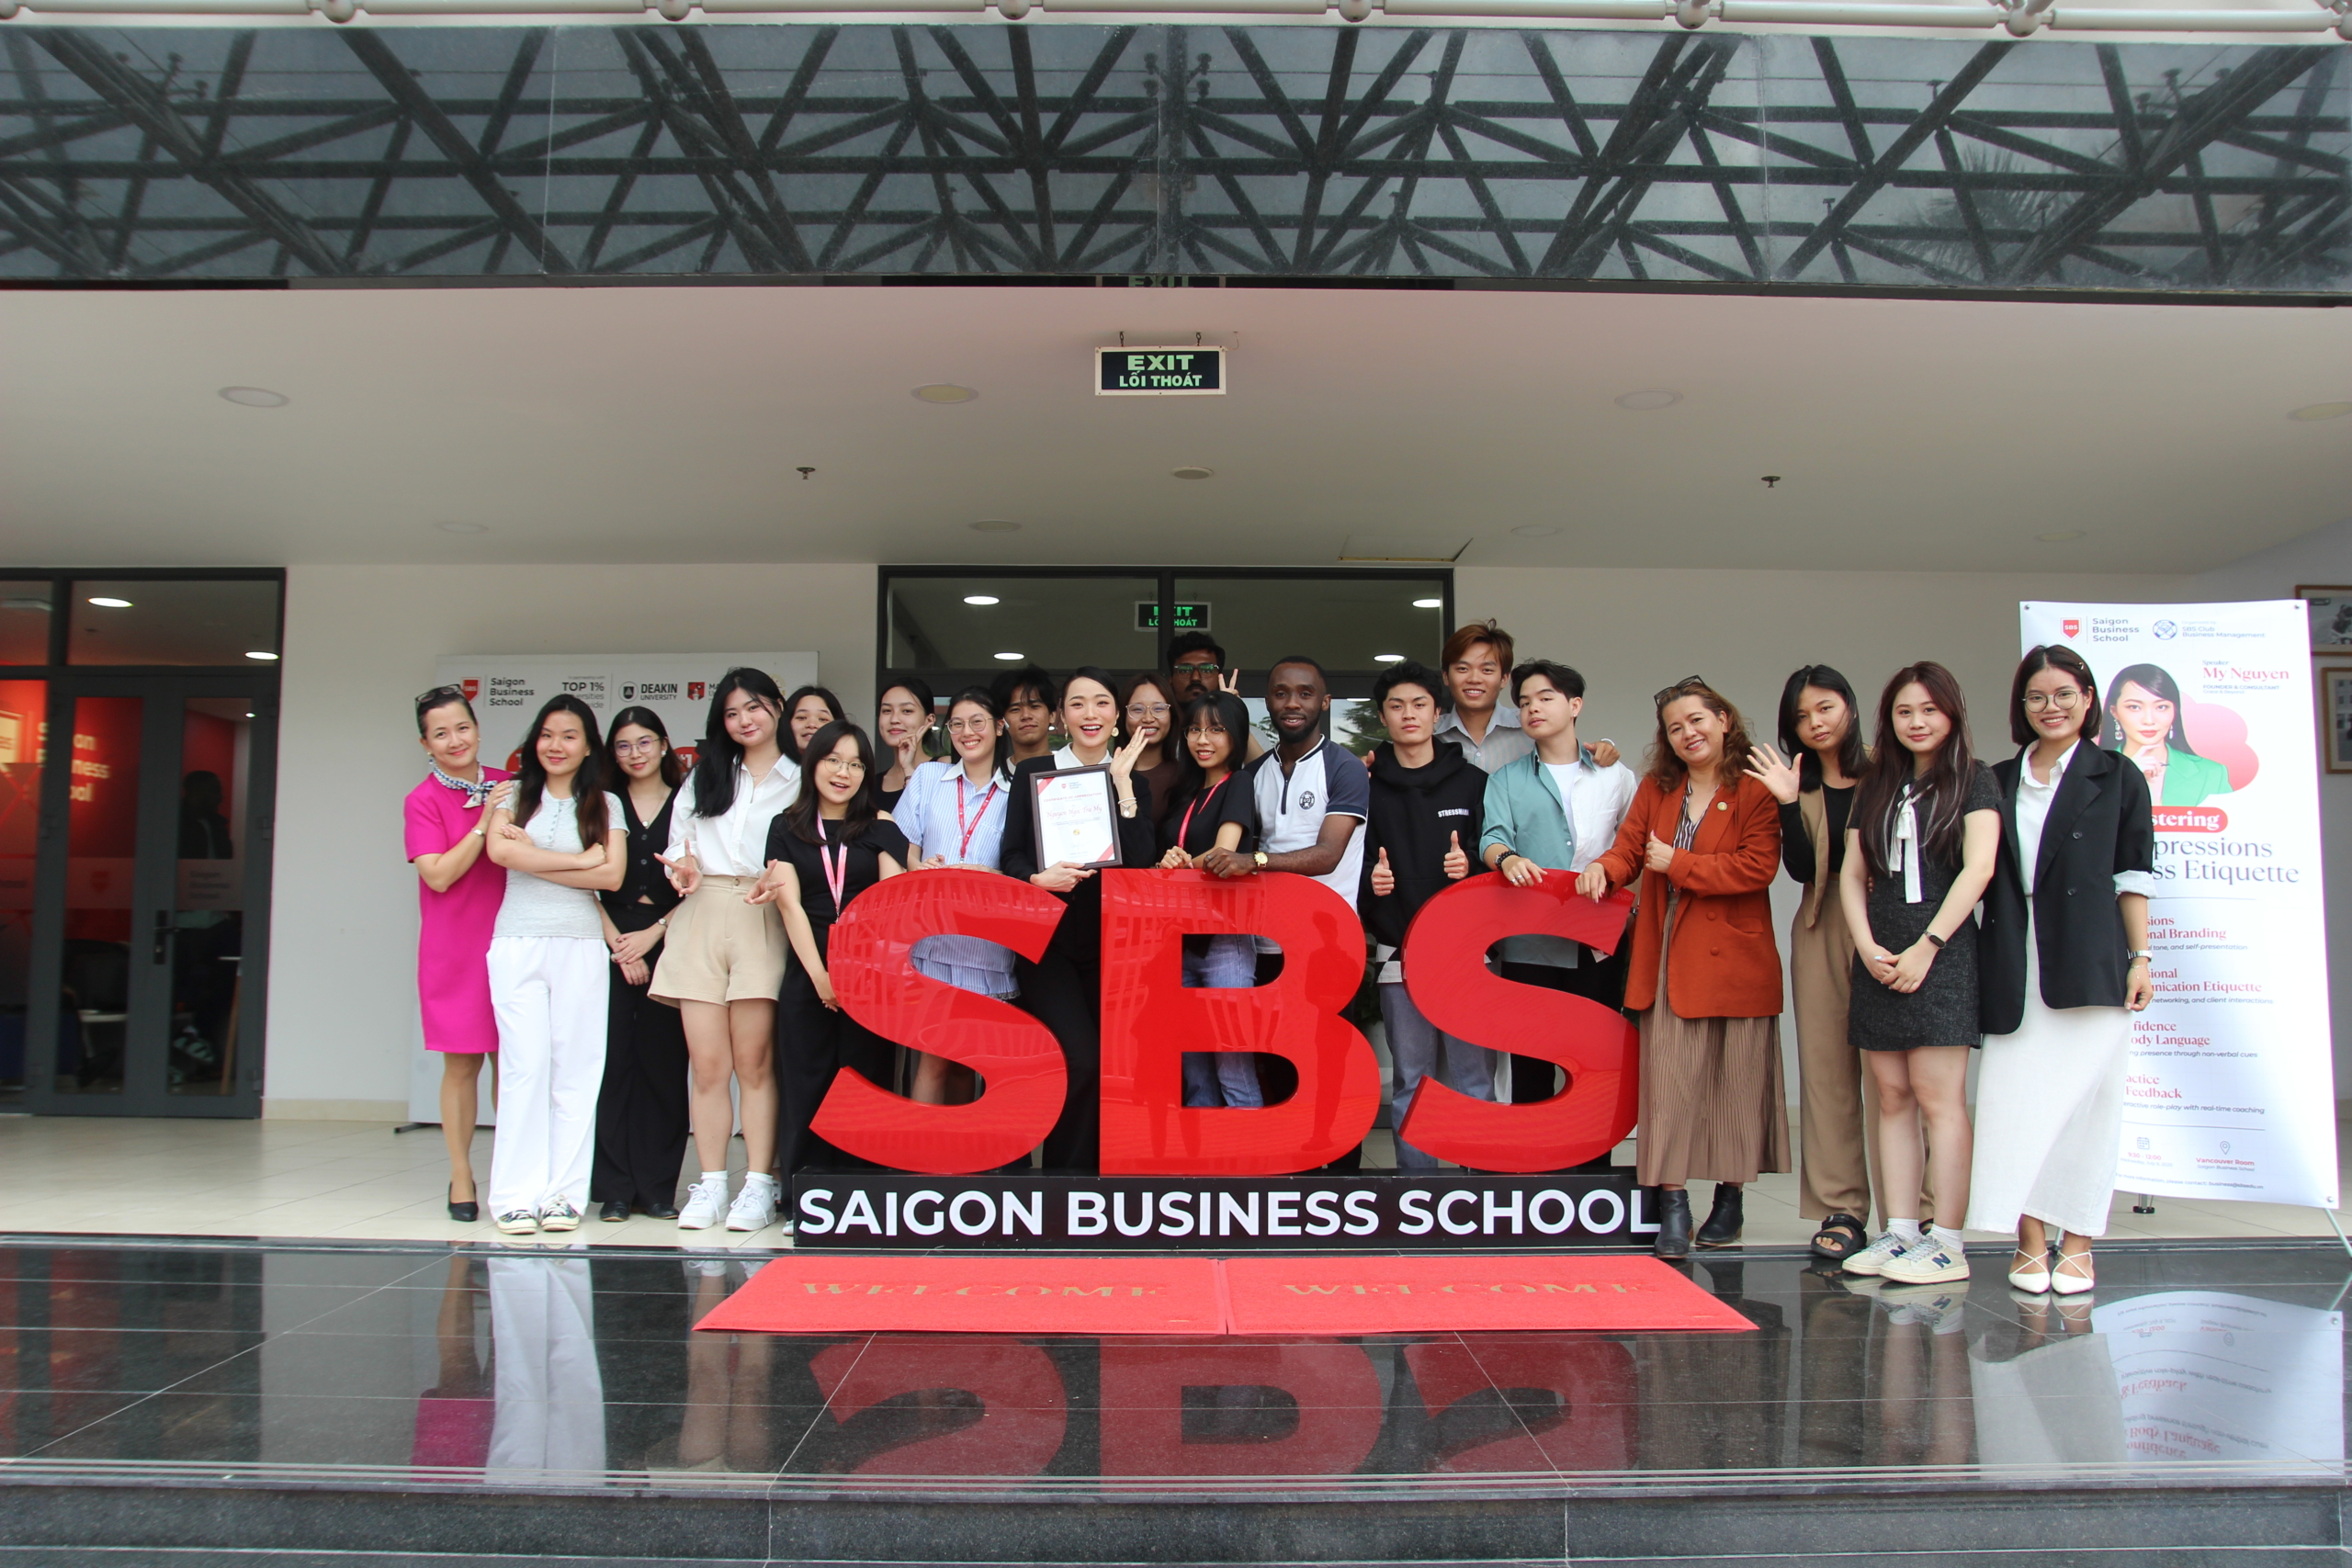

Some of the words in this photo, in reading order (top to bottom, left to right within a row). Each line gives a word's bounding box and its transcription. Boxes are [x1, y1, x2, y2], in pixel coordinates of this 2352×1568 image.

[1127, 355, 1194, 370] EXIT
[1119, 370, 1146, 387] LỐI
[1150, 372, 1203, 387] THOÁT
[2093, 617, 2129, 626] Saigon
[2203, 667, 2227, 681] My
[2231, 667, 2290, 682] Nguyen
[491, 677, 525, 687] Saigon
[562, 682, 586, 692] TOP
[590, 682, 605, 692] 1%
[640, 683, 678, 694] DEAKIN
[490, 698, 523, 706] School
[2152, 810, 2220, 831] stering
[2154, 837, 2273, 860] pressions
[2185, 860, 2300, 886] Etiquette
[2169, 928, 2226, 941] Branding
[2204, 981, 2262, 994] Etiquette
[808, 867, 1642, 1176] SBS
[2133, 1021, 2177, 1032] fidence
[2131, 1034, 2153, 1046] ody
[2155, 1034, 2211, 1047] Language
[2126, 1074, 2159, 1084] actice
[2125, 1086, 2182, 1099] Feedback
[2233, 1106, 2265, 1114] coaching
[798, 1189, 1043, 1236] SAIGON
[1068, 1189, 1379, 1236] BUSINESS
[1398, 1189, 1662, 1235] SCHOOL
